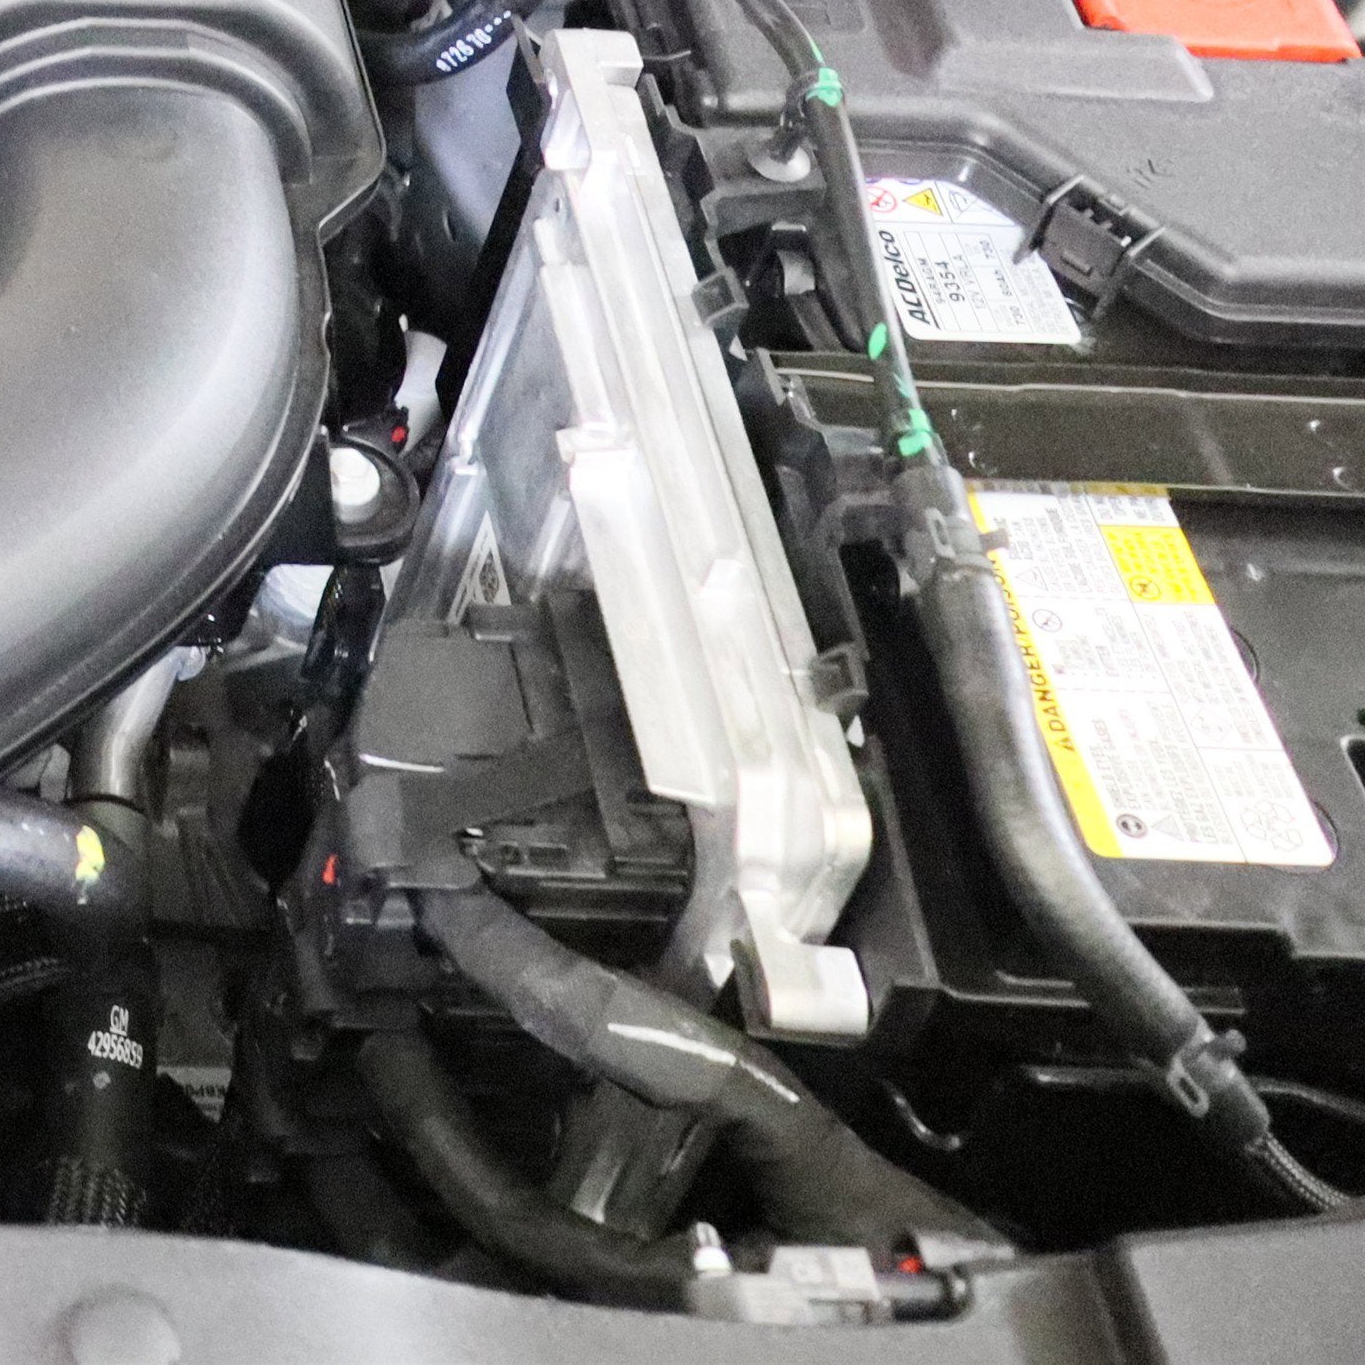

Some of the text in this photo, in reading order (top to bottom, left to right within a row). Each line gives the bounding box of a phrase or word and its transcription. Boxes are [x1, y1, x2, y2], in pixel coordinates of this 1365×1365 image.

[878, 230, 930, 326] ACDelco
[934, 260, 965, 303] 9354
[110, 1005, 129, 1033] GM
[87, 1031, 144, 1069] 42956859
